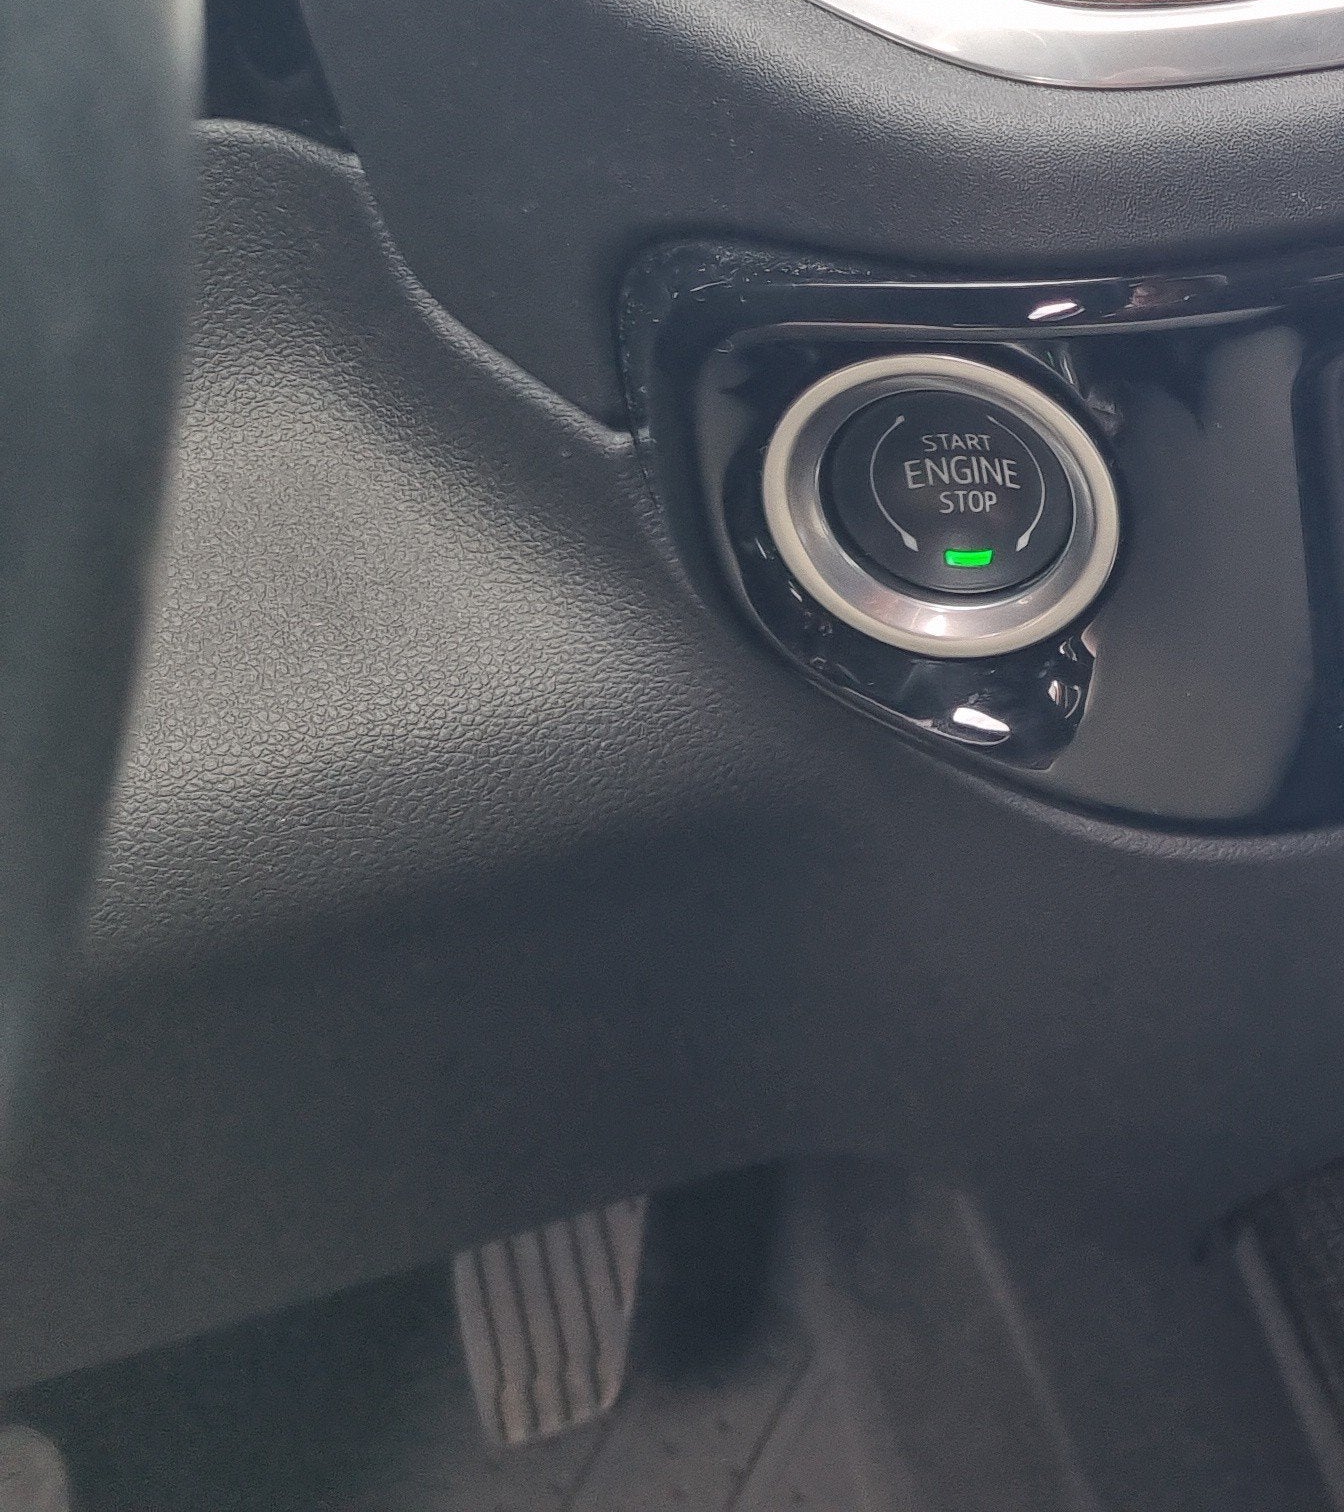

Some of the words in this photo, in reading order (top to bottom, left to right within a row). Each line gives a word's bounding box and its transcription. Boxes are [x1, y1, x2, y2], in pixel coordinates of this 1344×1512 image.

[921, 433, 992, 452] START
[904, 455, 1022, 490] ENGINE
[939, 490, 998, 514] STOP
